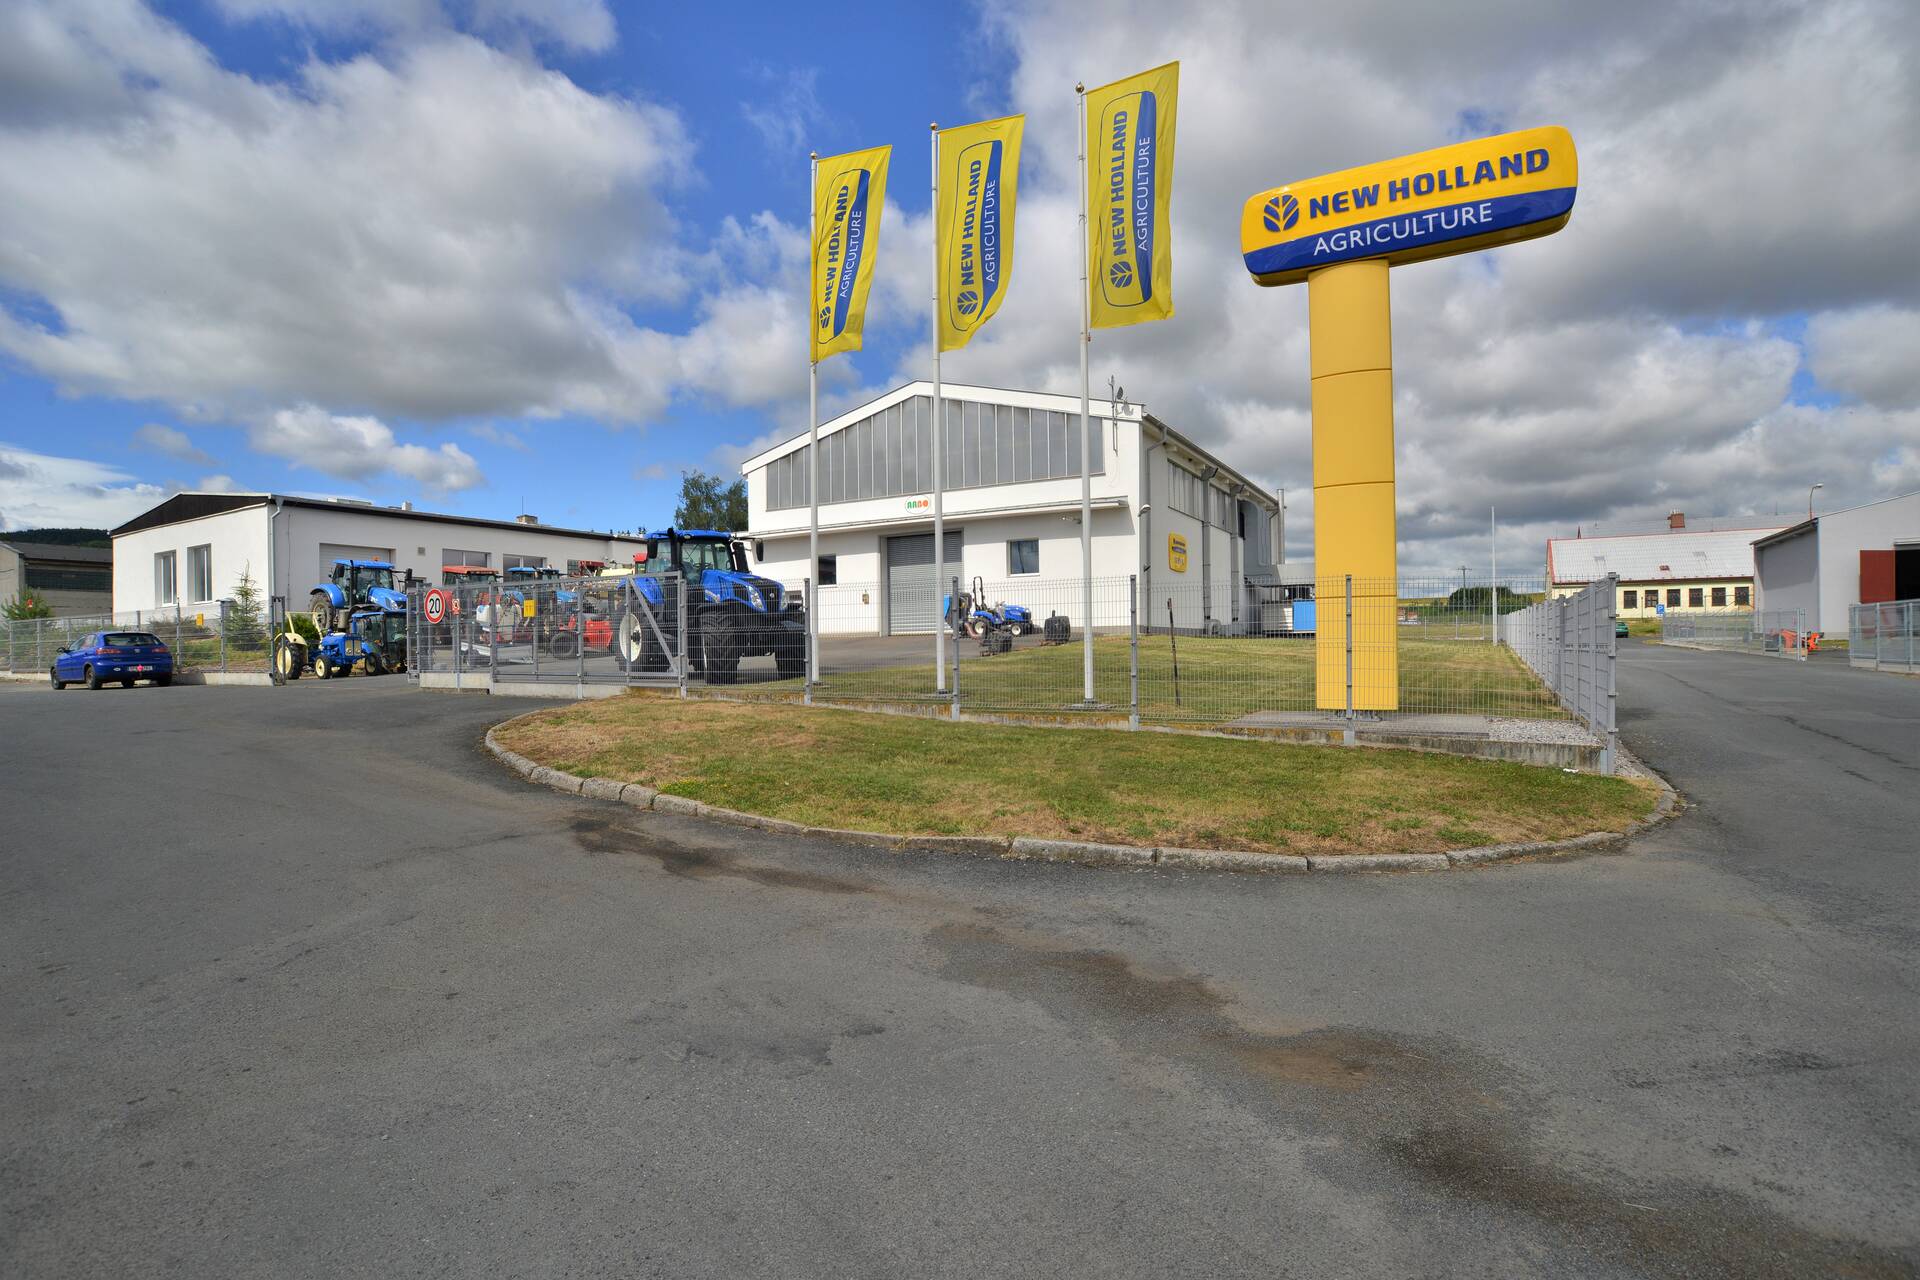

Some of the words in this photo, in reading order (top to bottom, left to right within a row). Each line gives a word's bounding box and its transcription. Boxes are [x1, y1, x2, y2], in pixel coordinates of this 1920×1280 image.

[1111, 111, 1128, 202] HOLLAND
[1309, 183, 1380, 219] NEW
[1389, 148, 1550, 202] HOLLAND
[962, 160, 982, 239] HOLLAND
[1136, 137, 1151, 251] AGRICULTURE
[1313, 203, 1493, 256] AGRICULTURE
[839, 210, 863, 298] AGRICULTURE
[961, 244, 975, 286] NEW
[985, 180, 996, 283] AGRICULTURE
[1112, 208, 1127, 256] NEW
[825, 266, 837, 301] NEW
[429, 598, 441, 614] 20
